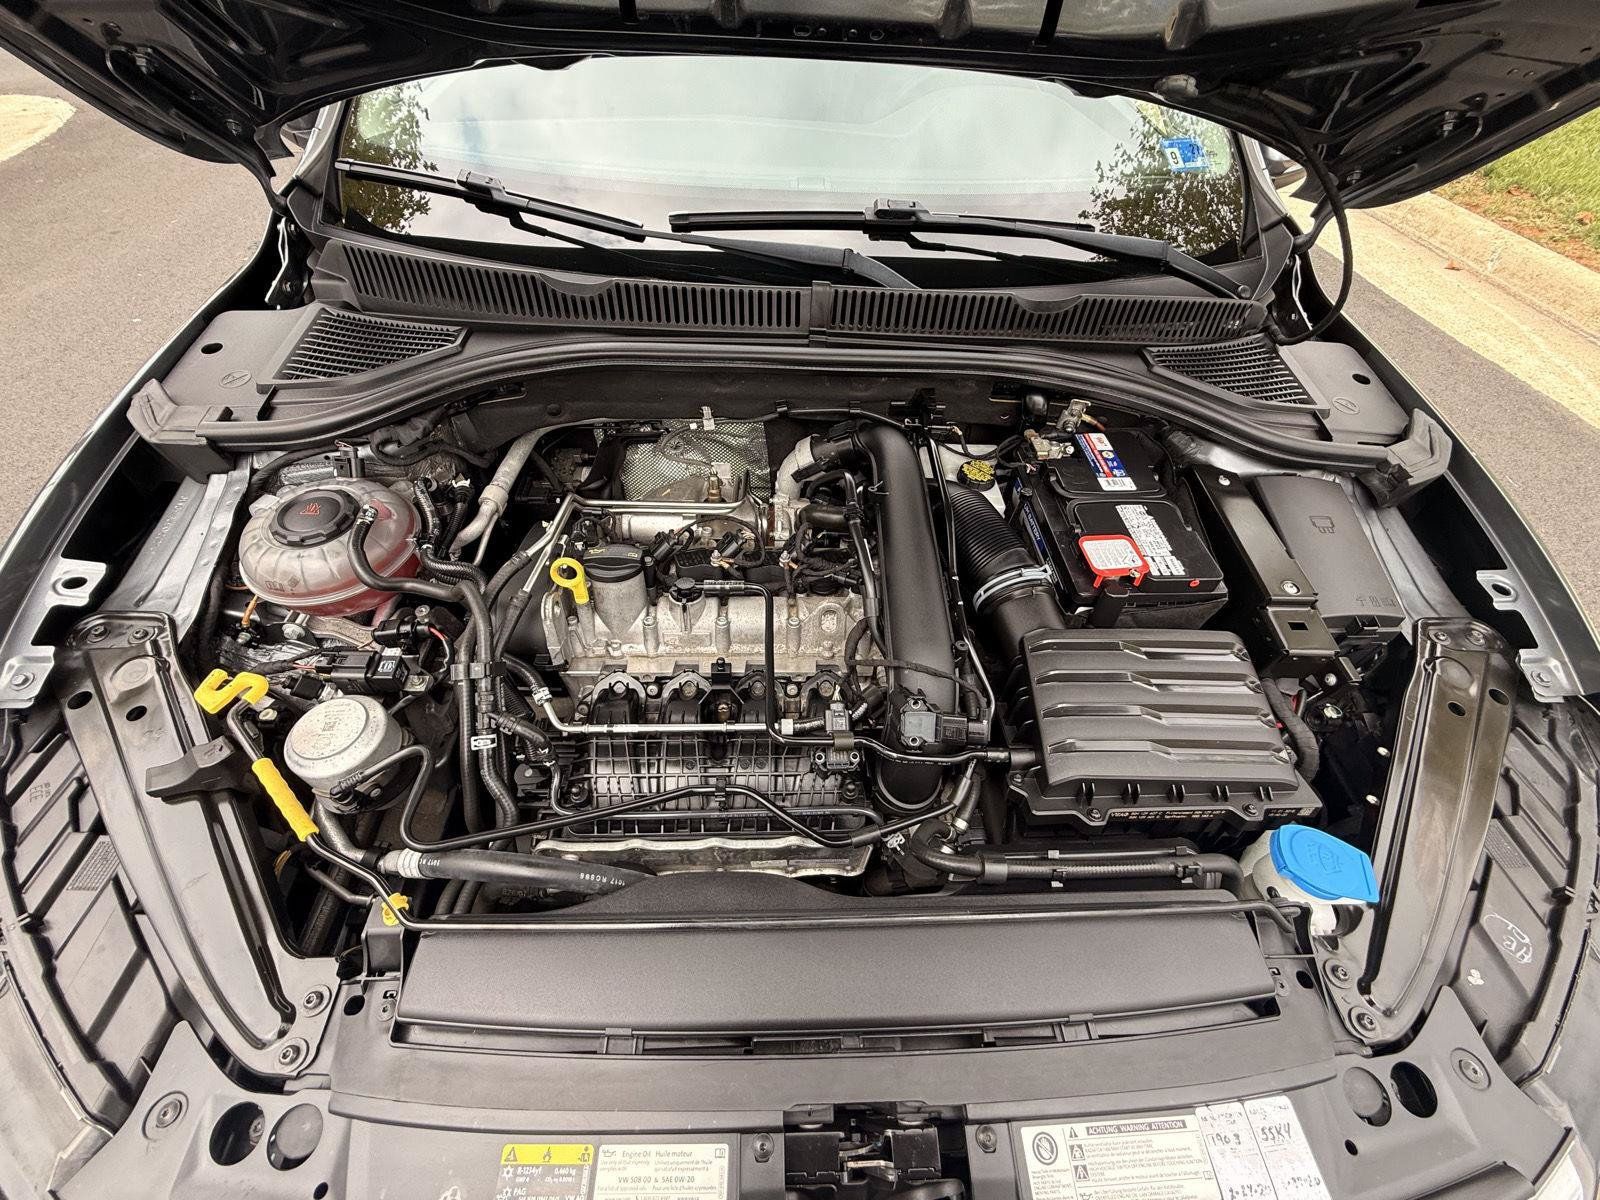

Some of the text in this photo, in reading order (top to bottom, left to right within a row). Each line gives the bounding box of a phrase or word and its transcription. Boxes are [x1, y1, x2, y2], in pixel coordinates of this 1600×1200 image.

[1170, 151, 1178, 165] 9
[1088, 1120, 1184, 1135] ACHTUNG WARNING ATTENTION
[671, 1150, 693, 1158] moteur
